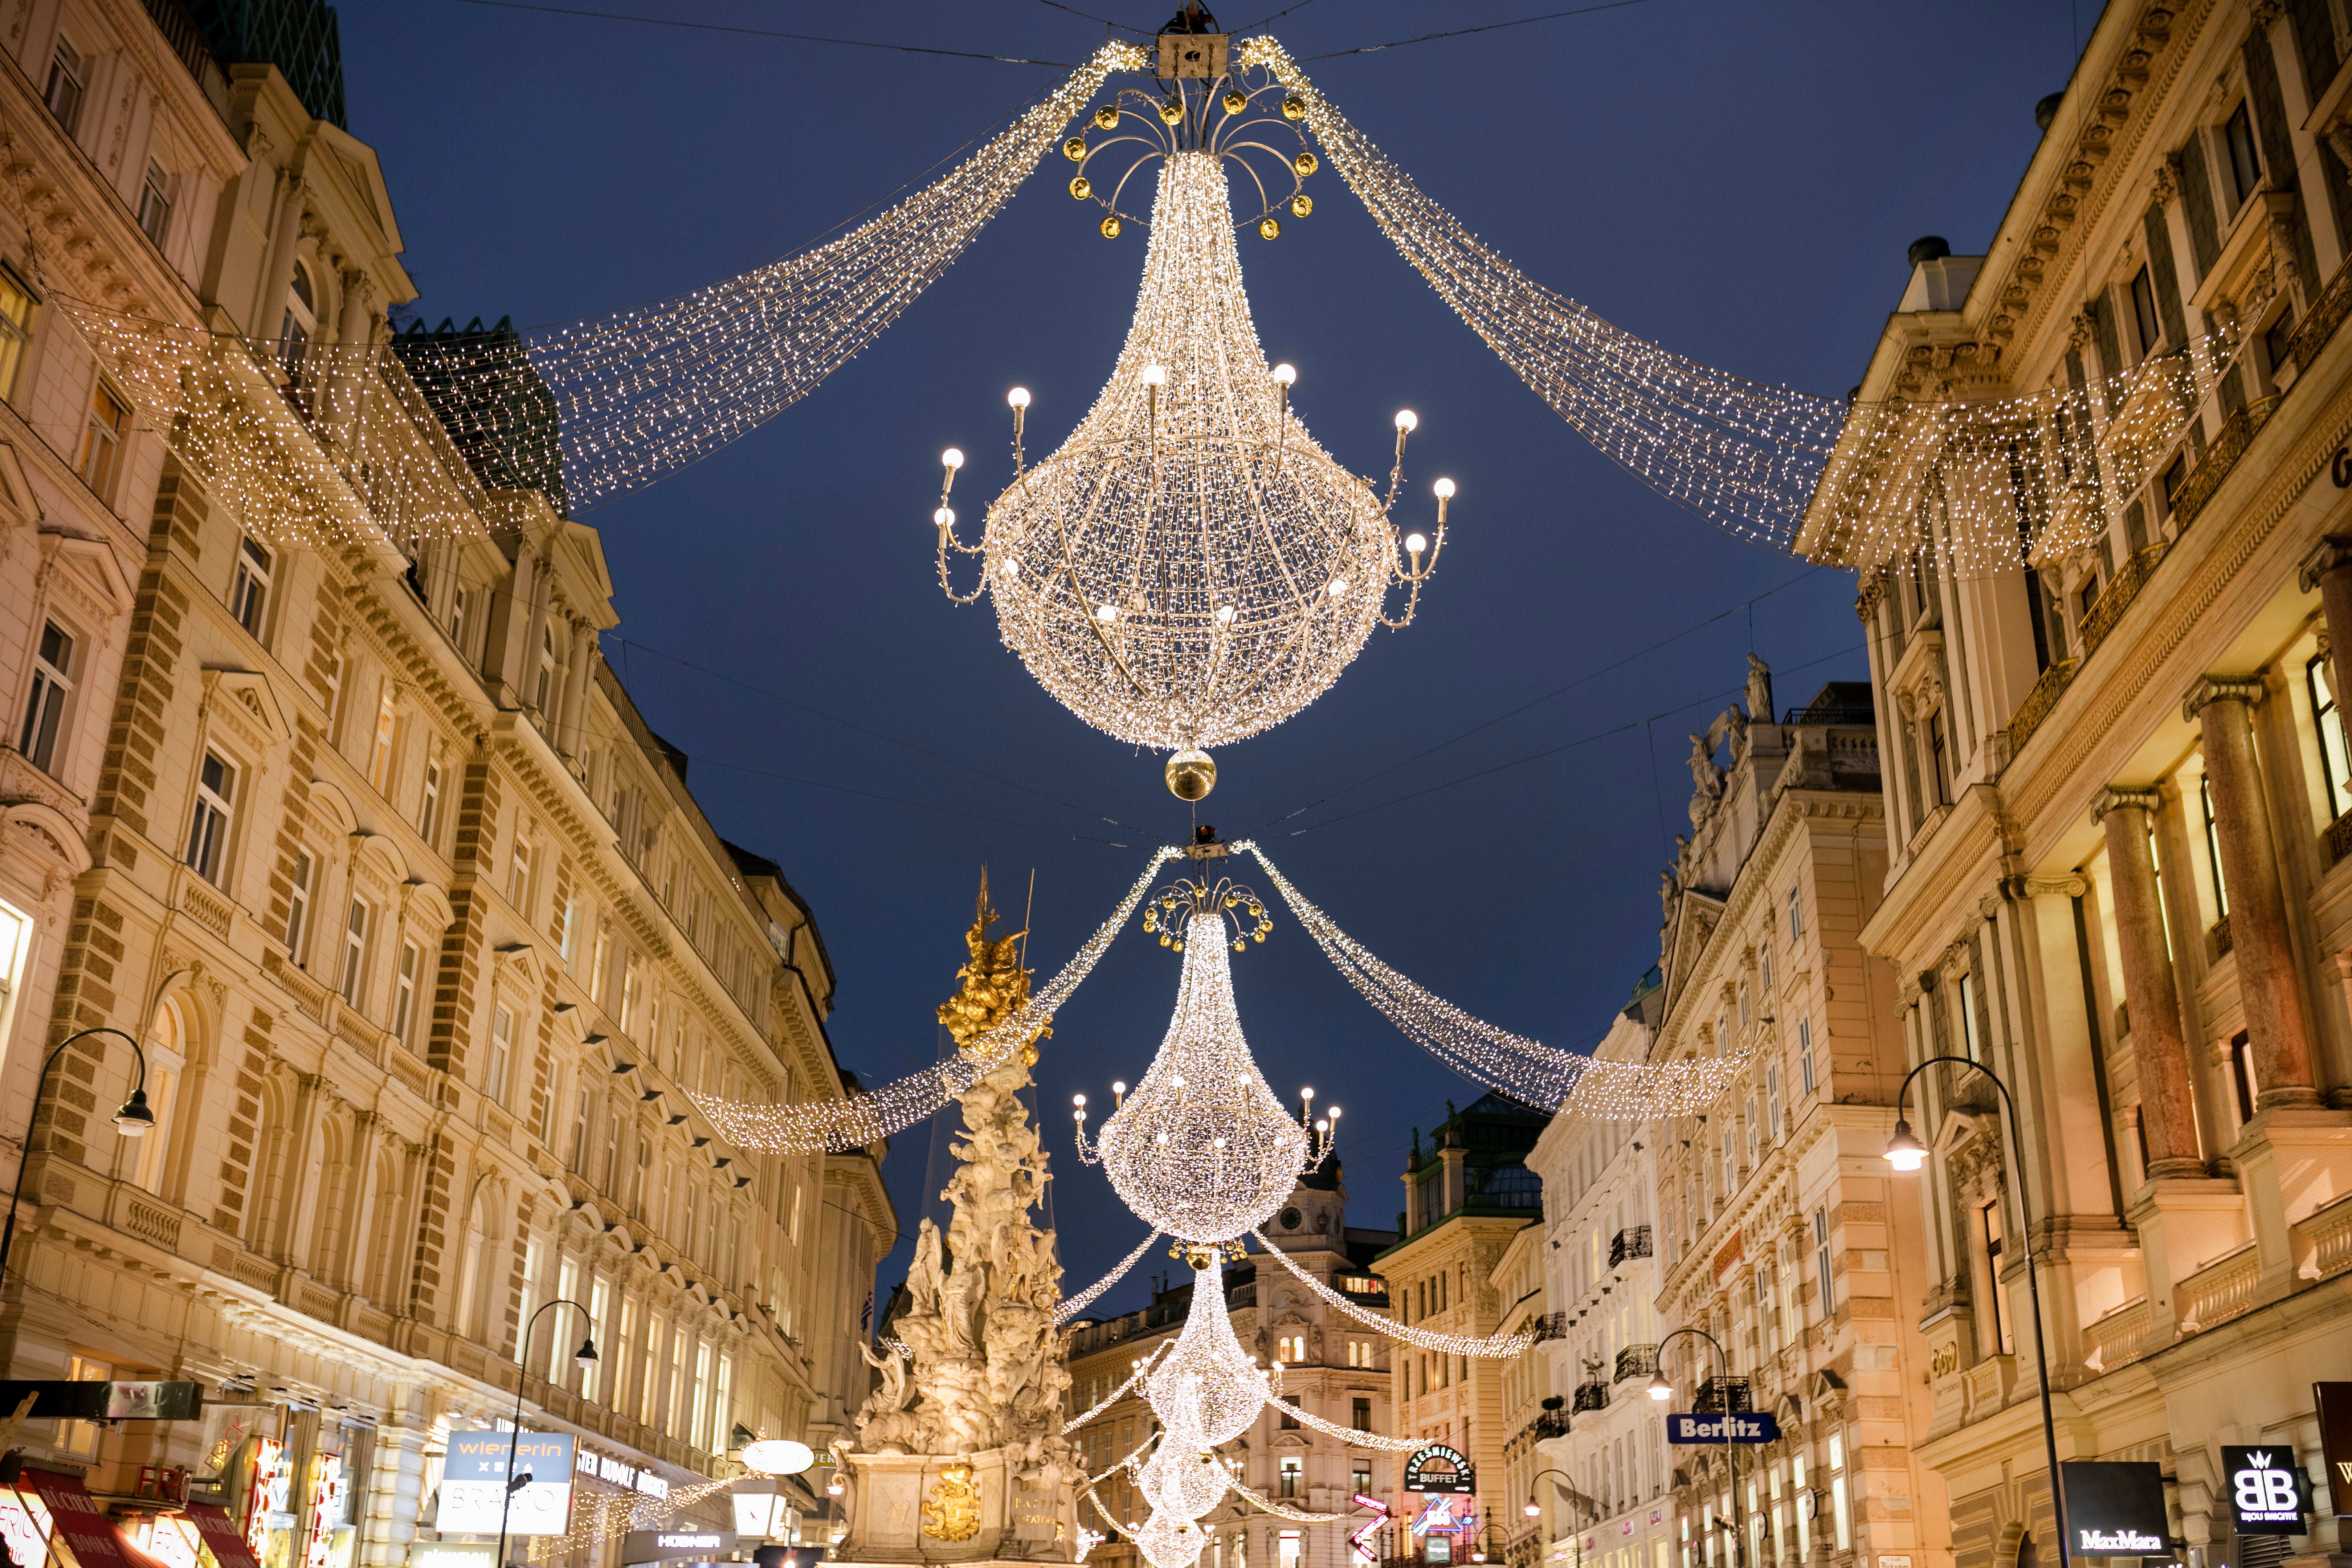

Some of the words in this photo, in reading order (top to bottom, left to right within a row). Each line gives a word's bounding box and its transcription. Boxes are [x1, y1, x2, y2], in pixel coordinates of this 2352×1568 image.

[1680, 1417, 1761, 1437] Berlitz
[600, 1457, 635, 1488] RUDOLF
[1420, 1473, 1458, 1483] BUFFET
[1019, 1481, 1052, 1493] DEO
[69, 1532, 118, 1557] BOOKS
[2080, 1530, 2162, 1550] MaxMara
